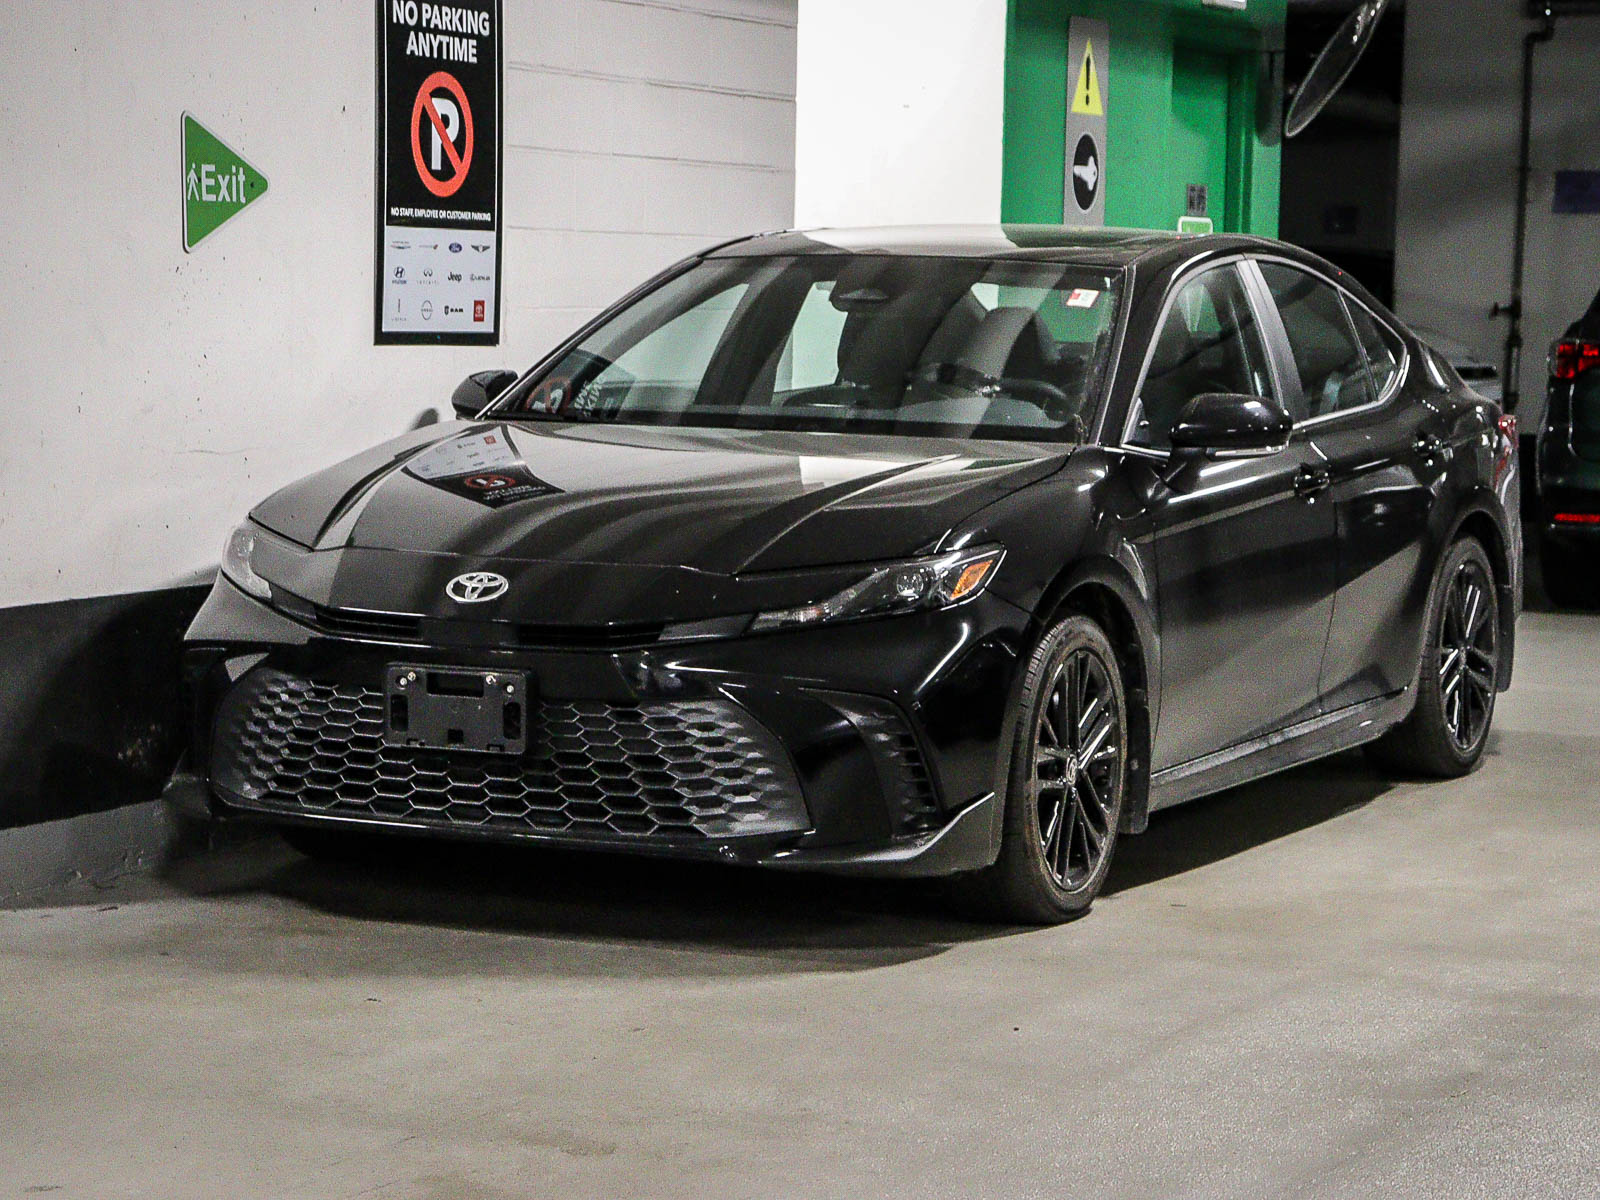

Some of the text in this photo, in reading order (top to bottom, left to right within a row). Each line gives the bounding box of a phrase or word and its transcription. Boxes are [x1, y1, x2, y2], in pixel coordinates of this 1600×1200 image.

[392, 0, 490, 37] NO PARKING
[406, 31, 478, 64] ANYTIME
[431, 97, 460, 171] P
[201, 163, 246, 204] Exit
[390, 206, 400, 217] NO
[414, 208, 439, 219] EMPLOYEE
[439, 209, 447, 219] OR
[446, 210, 471, 220] CUSTOMER
[471, 211, 491, 222] PARKING
